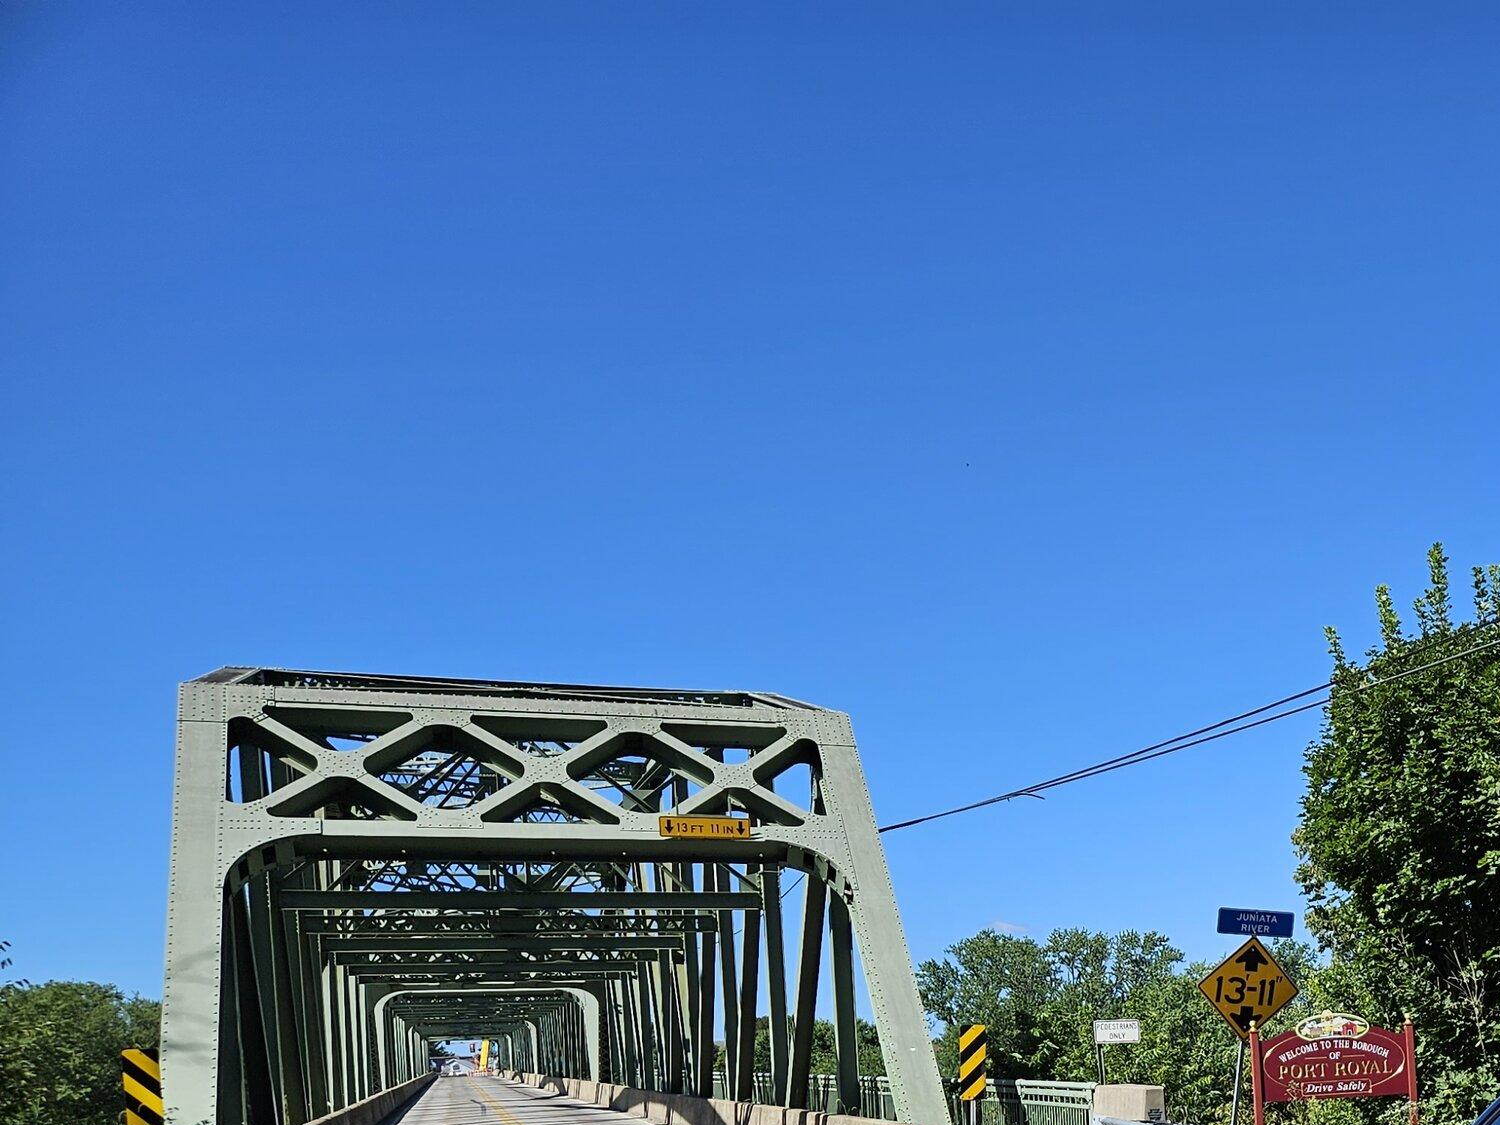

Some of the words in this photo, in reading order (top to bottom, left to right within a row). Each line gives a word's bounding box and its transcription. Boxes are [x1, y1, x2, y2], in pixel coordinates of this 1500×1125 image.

[676, 822, 688, 833] 13
[711, 824, 719, 833] 11
[723, 826, 734, 834] IN
[1236, 913, 1278, 923] JUNIATA
[1240, 924, 1270, 933] RIVER
[1096, 1022, 1137, 1030] PEDESTRIANS
[1109, 1032, 1126, 1040] ONLY
[1279, 1045, 1318, 1063] WELCOME
[1322, 1042, 1332, 1050] TO
[1334, 1040, 1350, 1049] THE
[1352, 1041, 1390, 1058] BOROUGH
[1329, 1052, 1341, 1060] OF
[1278, 1062, 1328, 1080] PORT
[1334, 1059, 1393, 1076] ROYAL
[1306, 1082, 1332, 1093] Drive
[1336, 1080, 1367, 1092] Safely
